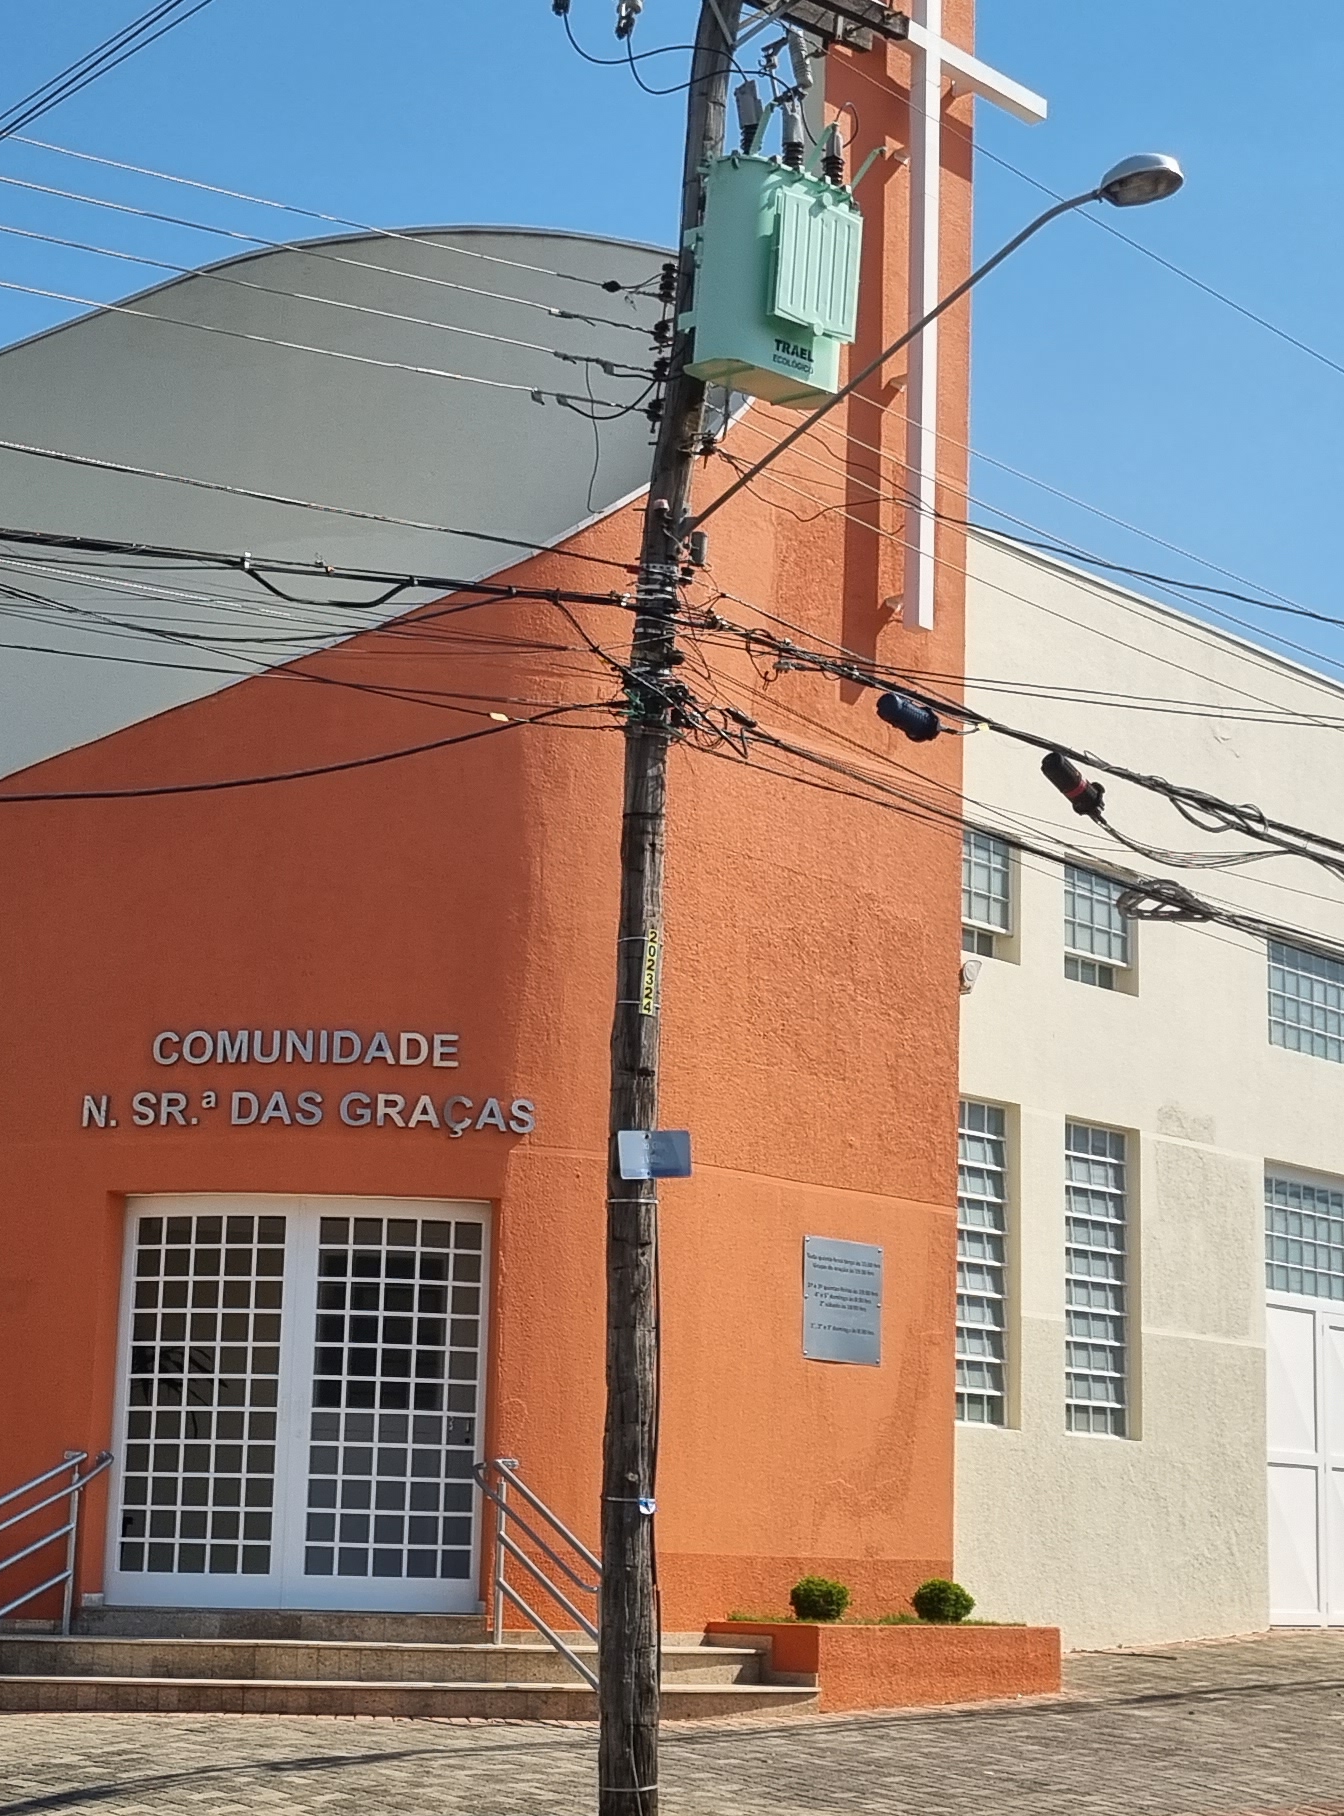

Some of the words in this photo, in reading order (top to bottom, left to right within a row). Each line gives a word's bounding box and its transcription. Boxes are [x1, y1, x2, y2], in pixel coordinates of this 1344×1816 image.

[774, 338, 814, 362] TRAEL
[643, 930, 658, 1014] 202324
[152, 1029, 460, 1068] COMUNIDADE
[81, 1094, 117, 1128] N.
[231, 1091, 323, 1126] DAS
[340, 1092, 536, 1137] GRAÇAS
